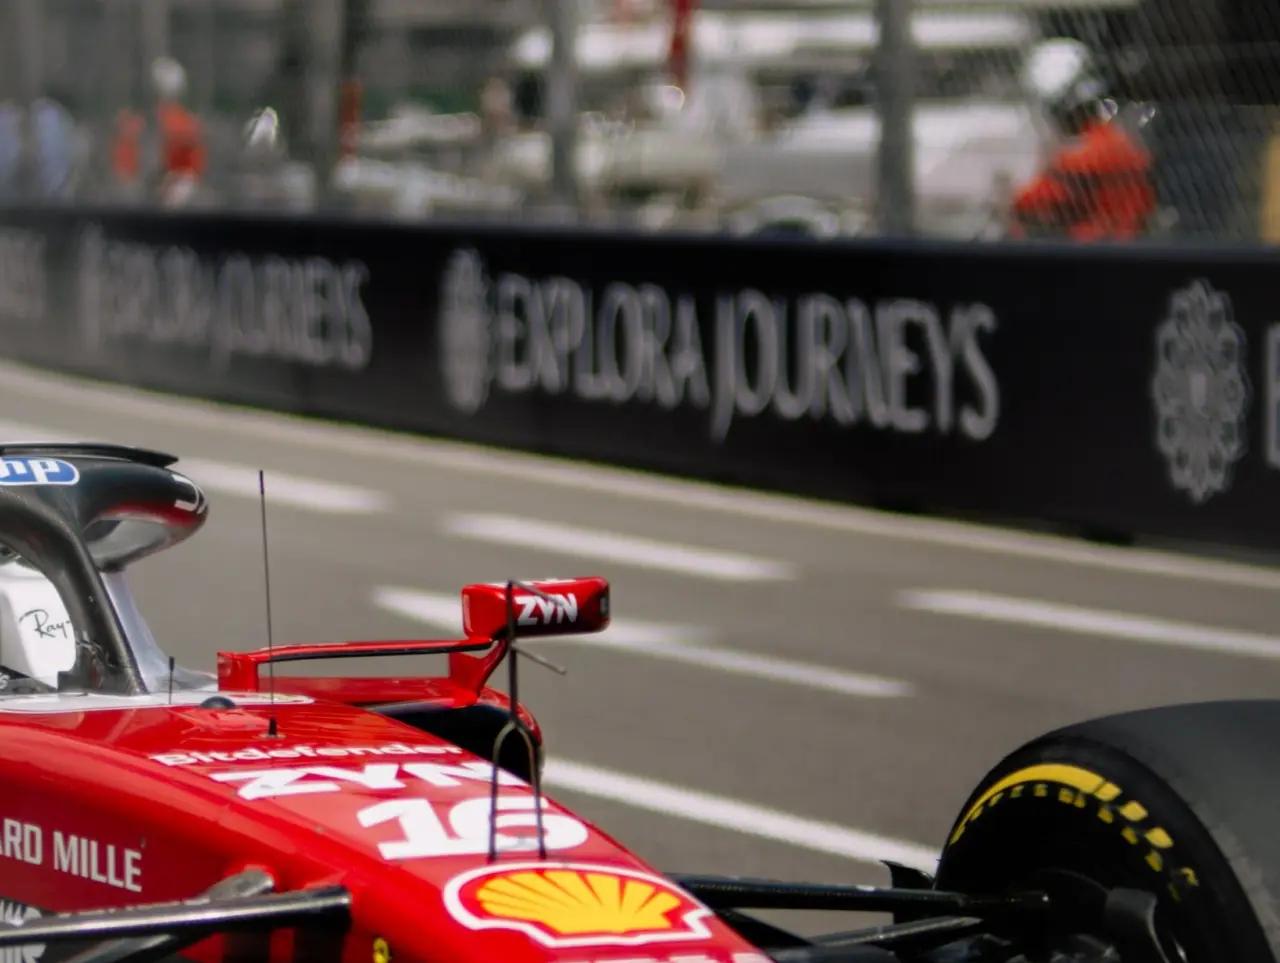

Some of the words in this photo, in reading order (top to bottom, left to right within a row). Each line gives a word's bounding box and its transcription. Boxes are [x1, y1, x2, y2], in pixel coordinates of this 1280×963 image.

[499, 273, 710, 409] EXPLORA
[711, 289, 1000, 443] JOURNEYS
[19, 608, 70, 640] Ray-
[514, 592, 579, 625] ZYN
[150, 743, 463, 767] Bitdefender
[209, 762, 531, 801] ZYN
[356, 796, 589, 860] 16
[53, 831, 142, 893] MILLE
